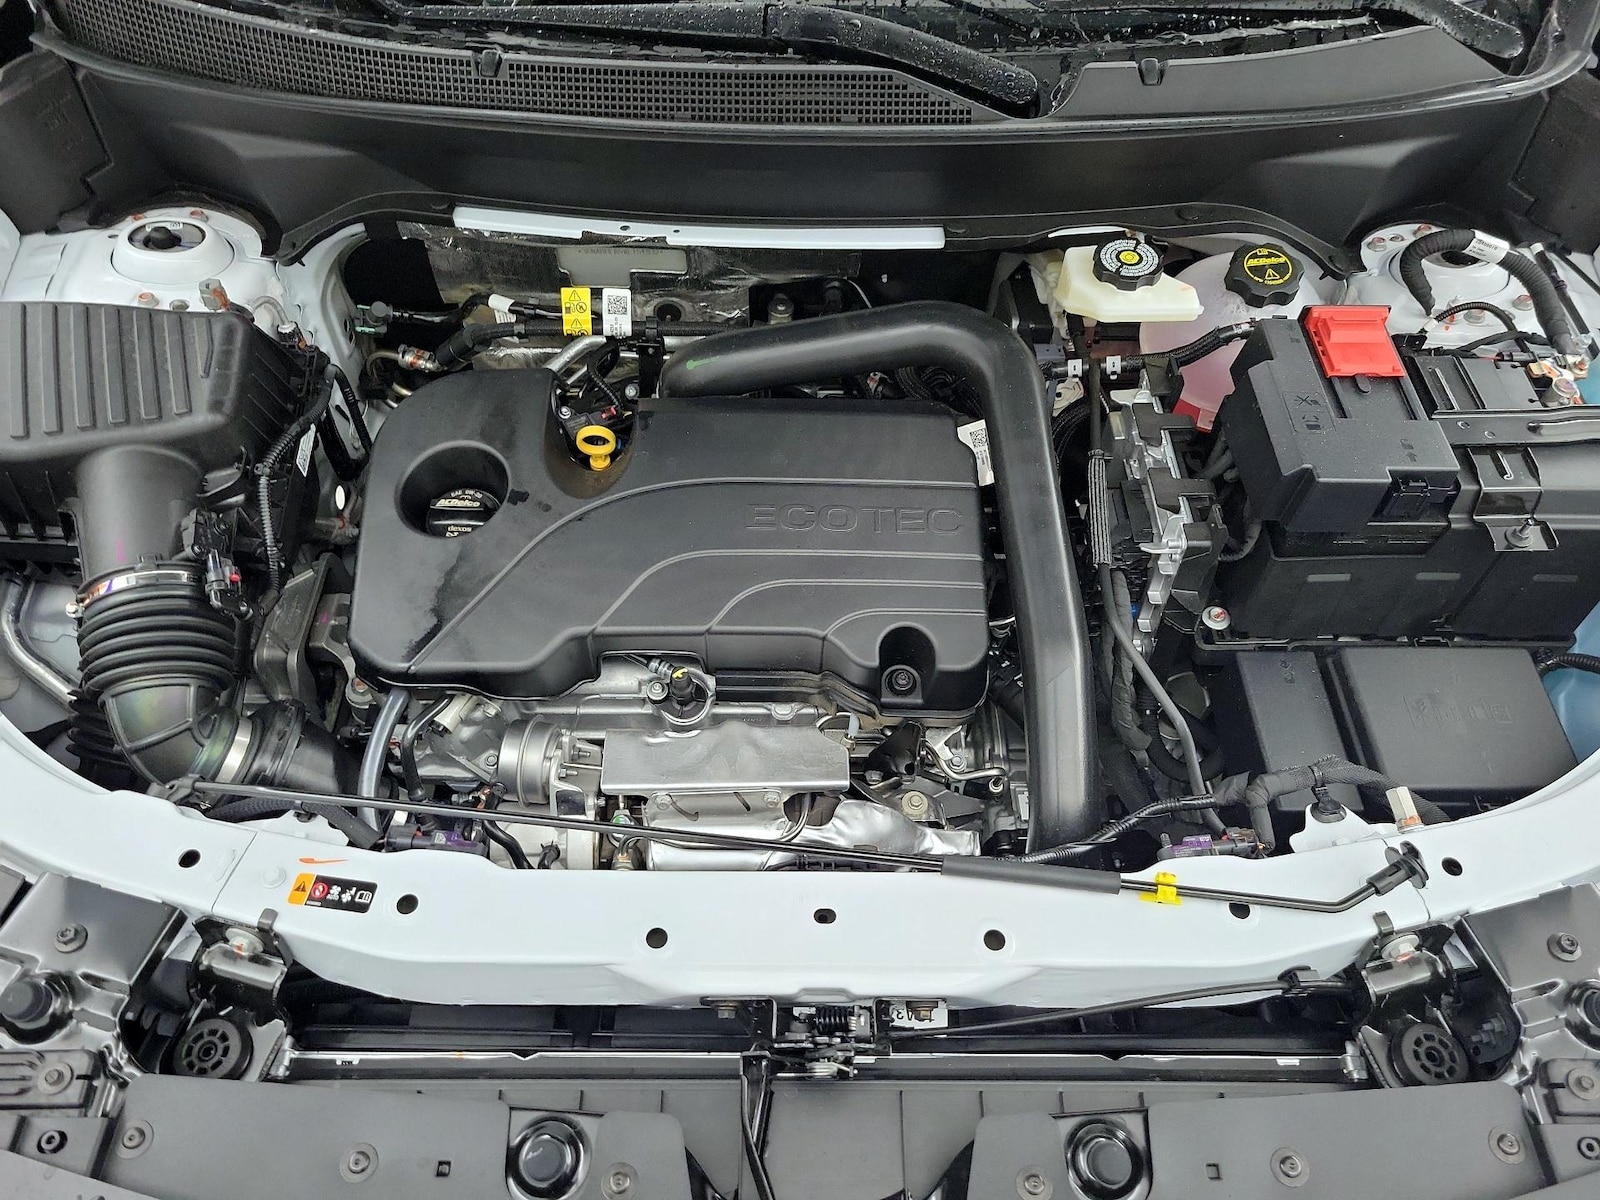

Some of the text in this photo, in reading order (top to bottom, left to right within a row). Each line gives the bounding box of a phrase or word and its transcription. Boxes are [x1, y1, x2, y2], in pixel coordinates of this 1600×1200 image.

[1247, 257, 1287, 267] ACDelco
[435, 499, 481, 508] ACDelco
[746, 503, 964, 535] ECOTEC
[447, 525, 473, 533] dexos
